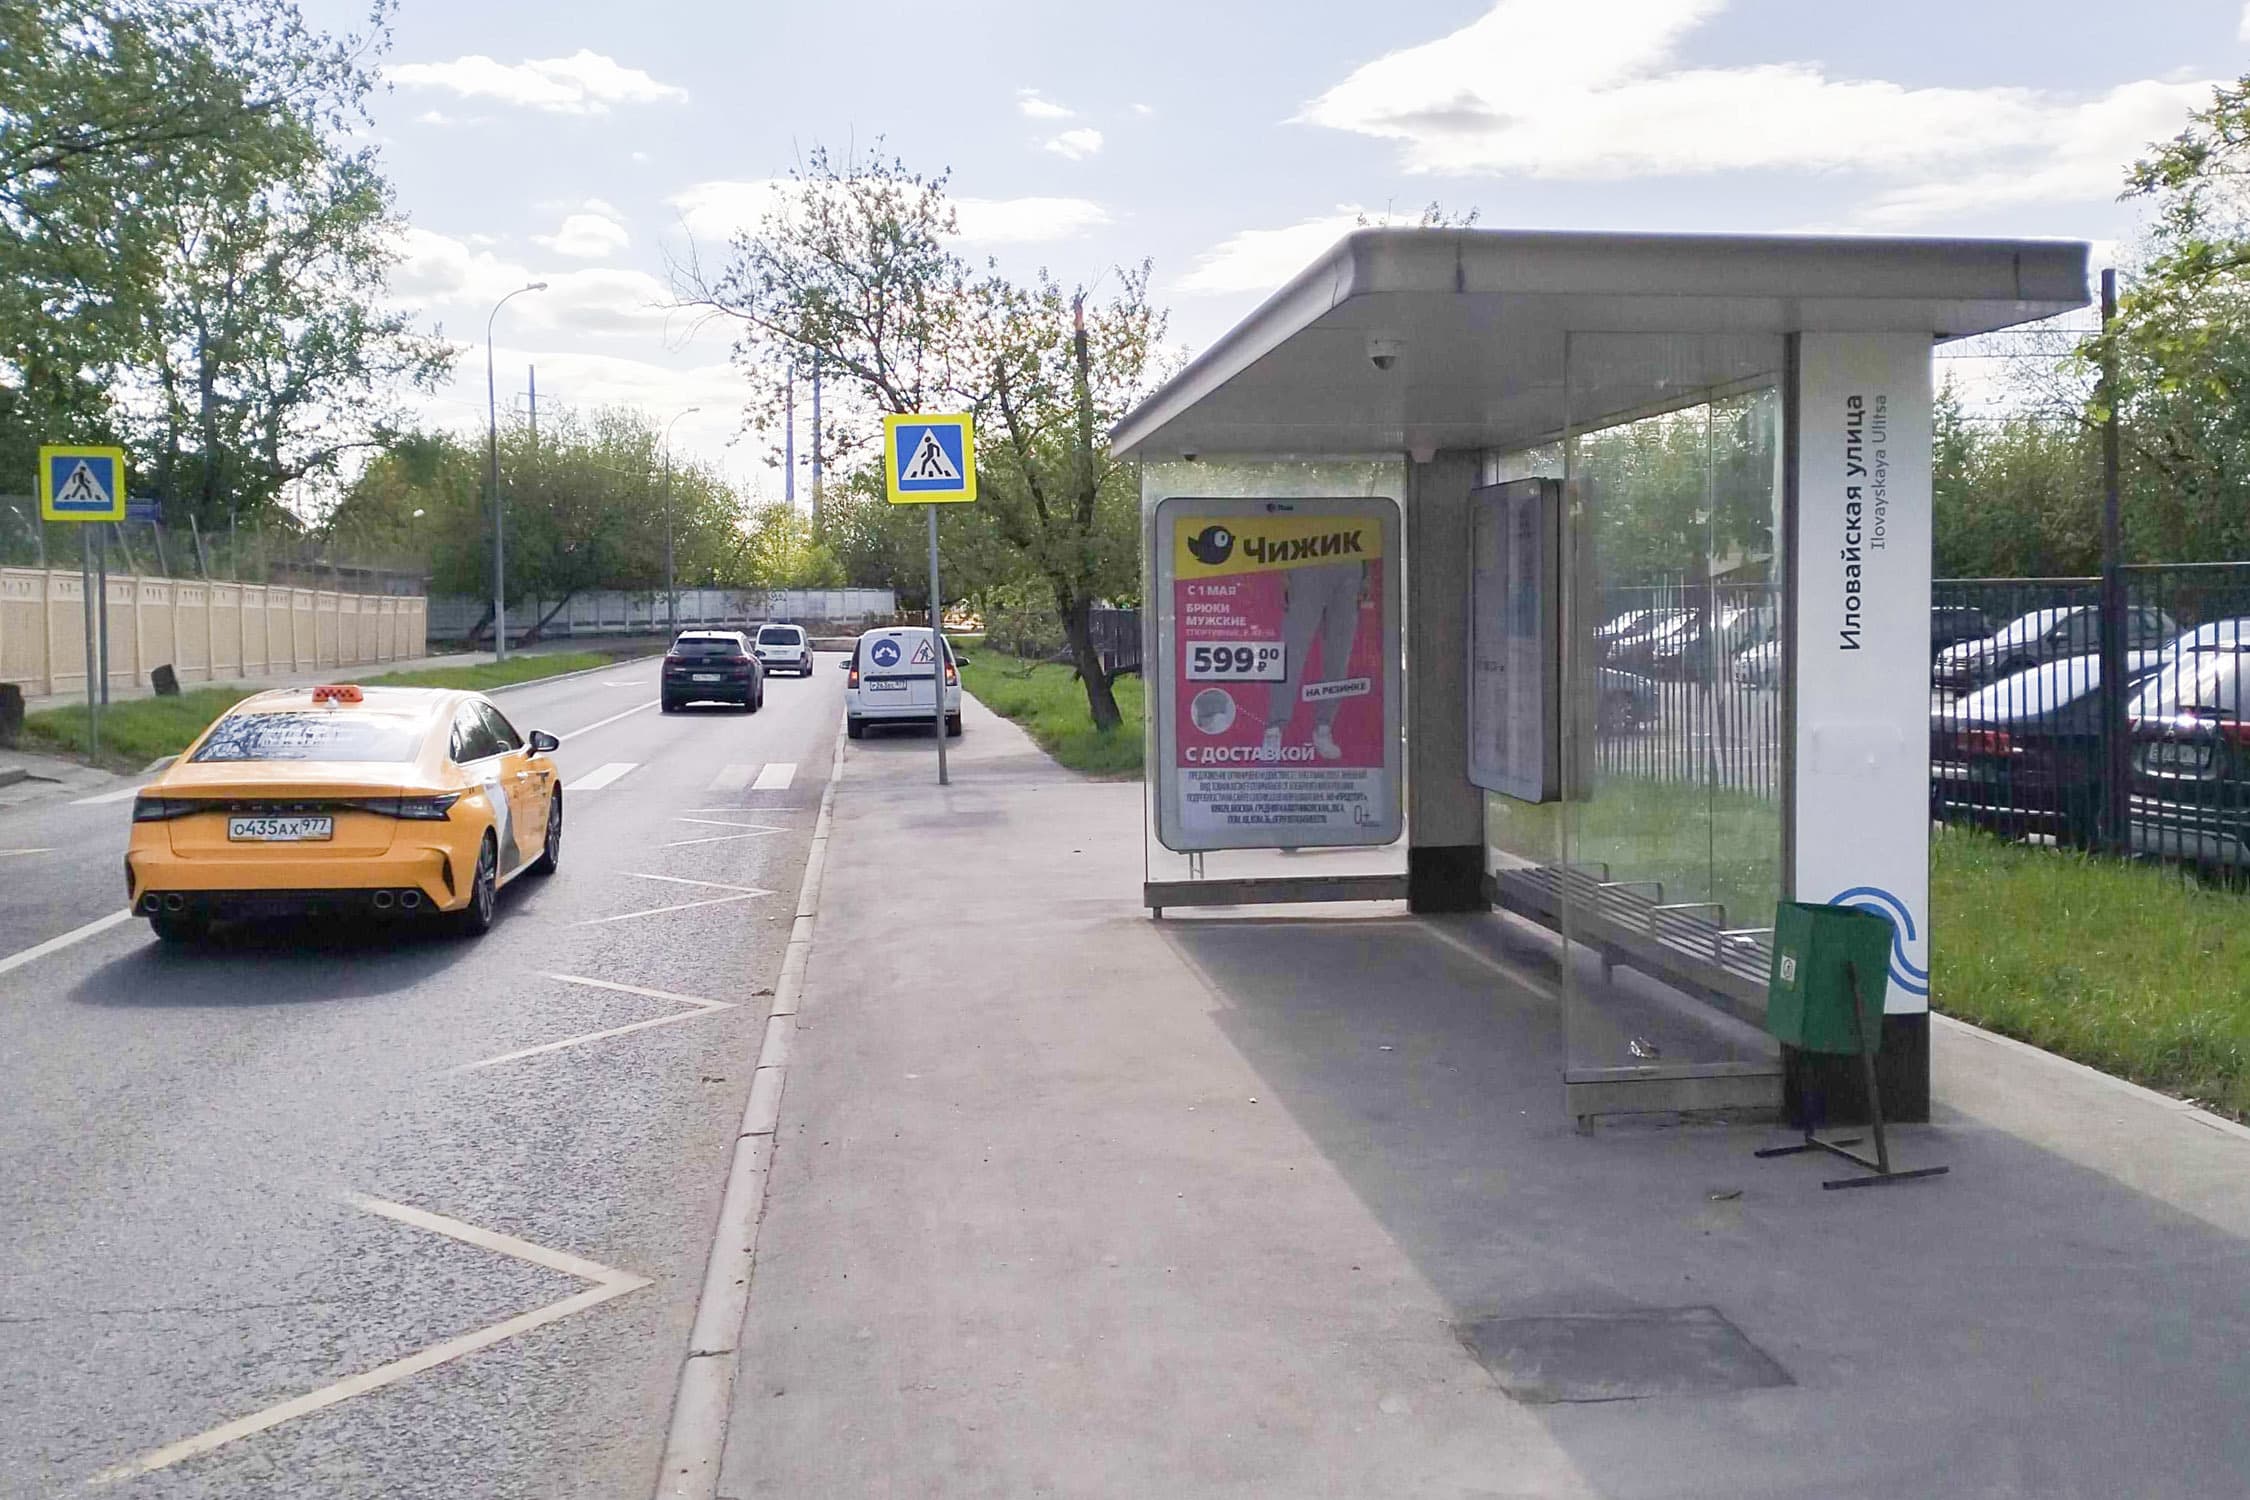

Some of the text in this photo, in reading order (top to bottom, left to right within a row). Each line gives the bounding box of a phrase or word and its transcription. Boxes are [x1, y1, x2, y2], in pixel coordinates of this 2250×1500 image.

[1871, 395, 1889, 550] Ilovayskaya Ulitsa
[1839, 394, 1867, 651] Иловайская улица
[1199, 586, 1205, 596] 1
[1186, 603, 1230, 614] БРЮКИ
[1186, 616, 1247, 626] МУЖСКИЕ
[1193, 647, 1279, 673] 599 00
[1305, 681, 1367, 697] НА РЕЗИНКЕ
[1185, 742, 1315, 764] С ДОСТАВКОЙ
